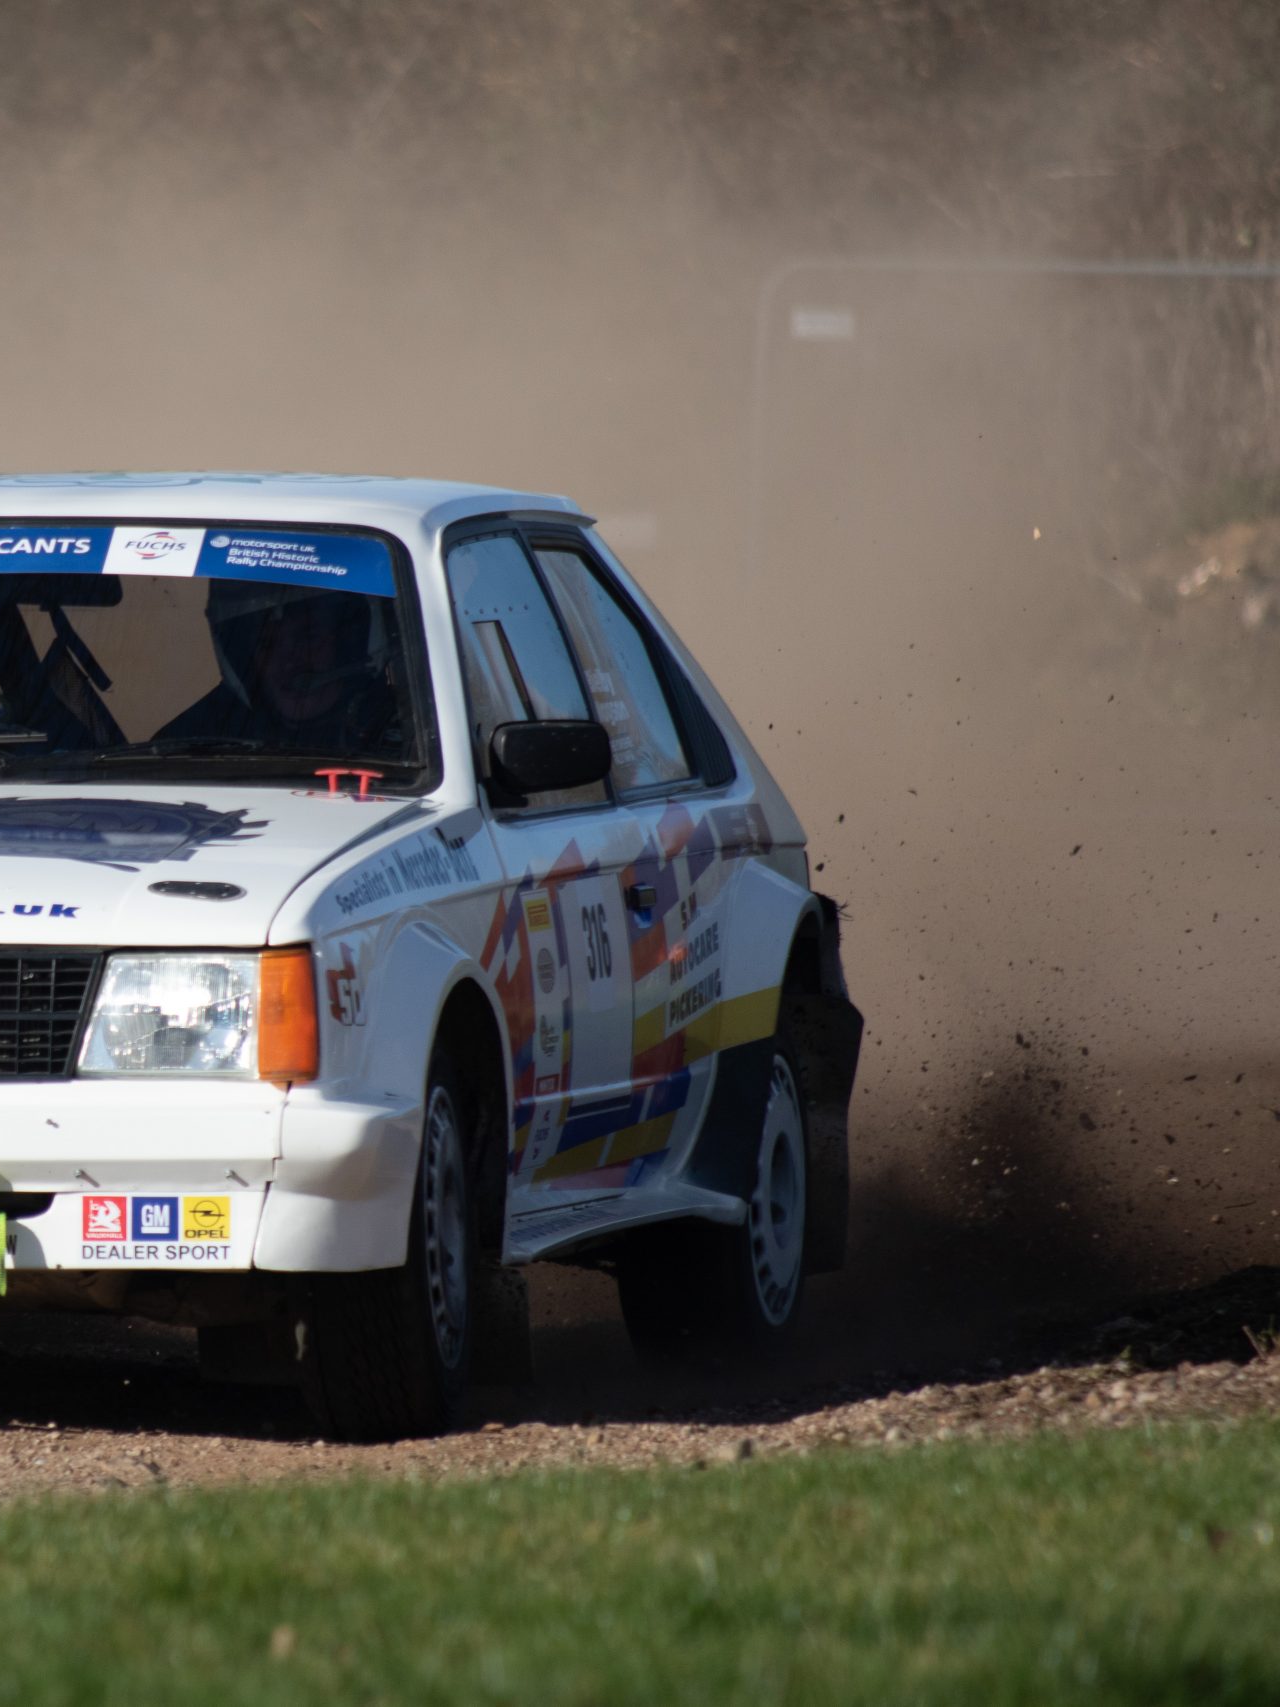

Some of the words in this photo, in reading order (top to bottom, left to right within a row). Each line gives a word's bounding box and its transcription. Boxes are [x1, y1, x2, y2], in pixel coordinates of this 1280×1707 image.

[124, 540, 187, 552] FUCHS
[231, 538, 299, 551] motorsport
[299, 544, 318, 553] uk
[228, 548, 270, 559] British
[271, 551, 320, 564] Historic
[226, 556, 258, 567] Rally
[258, 559, 348, 576] Championship
[581, 903, 613, 982] 316
[668, 967, 722, 1028] PICKERING
[141, 1204, 170, 1227] GM
[184, 1229, 229, 1239] OPEL
[82, 1245, 159, 1260] DEALER
[165, 1245, 231, 1260] SPORT
